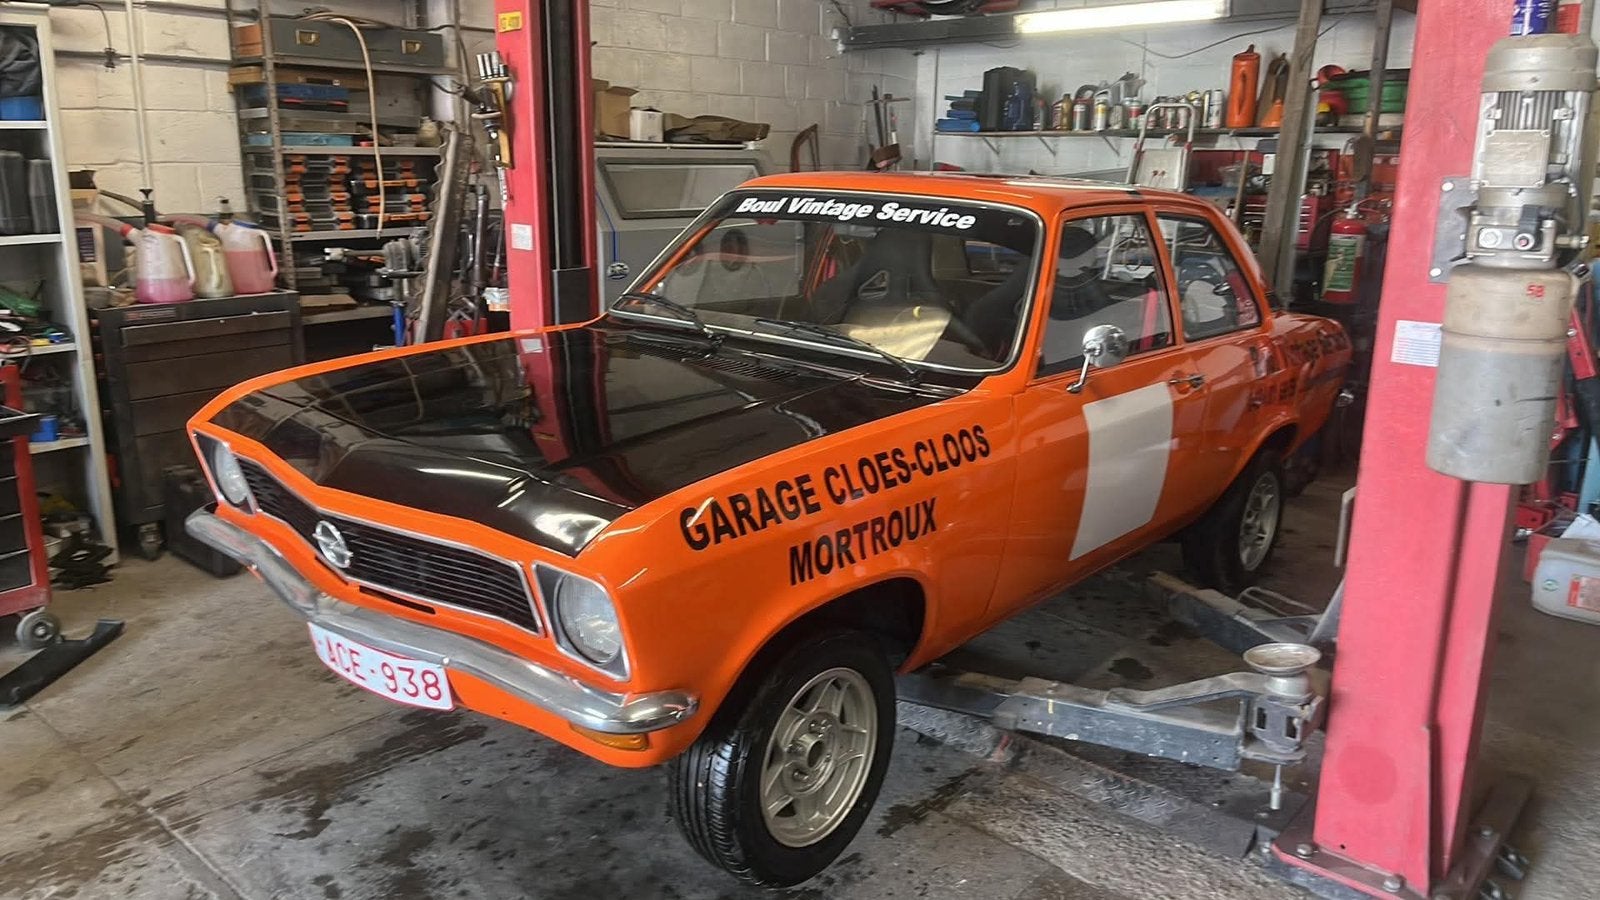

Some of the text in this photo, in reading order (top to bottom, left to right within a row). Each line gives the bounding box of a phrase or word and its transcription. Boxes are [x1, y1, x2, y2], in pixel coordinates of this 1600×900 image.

[735, 197, 976, 229] Boul Vintage Service
[679, 425, 990, 551] GARAGE CLOES-CLOOS
[789, 497, 937, 586] MORTROUX
